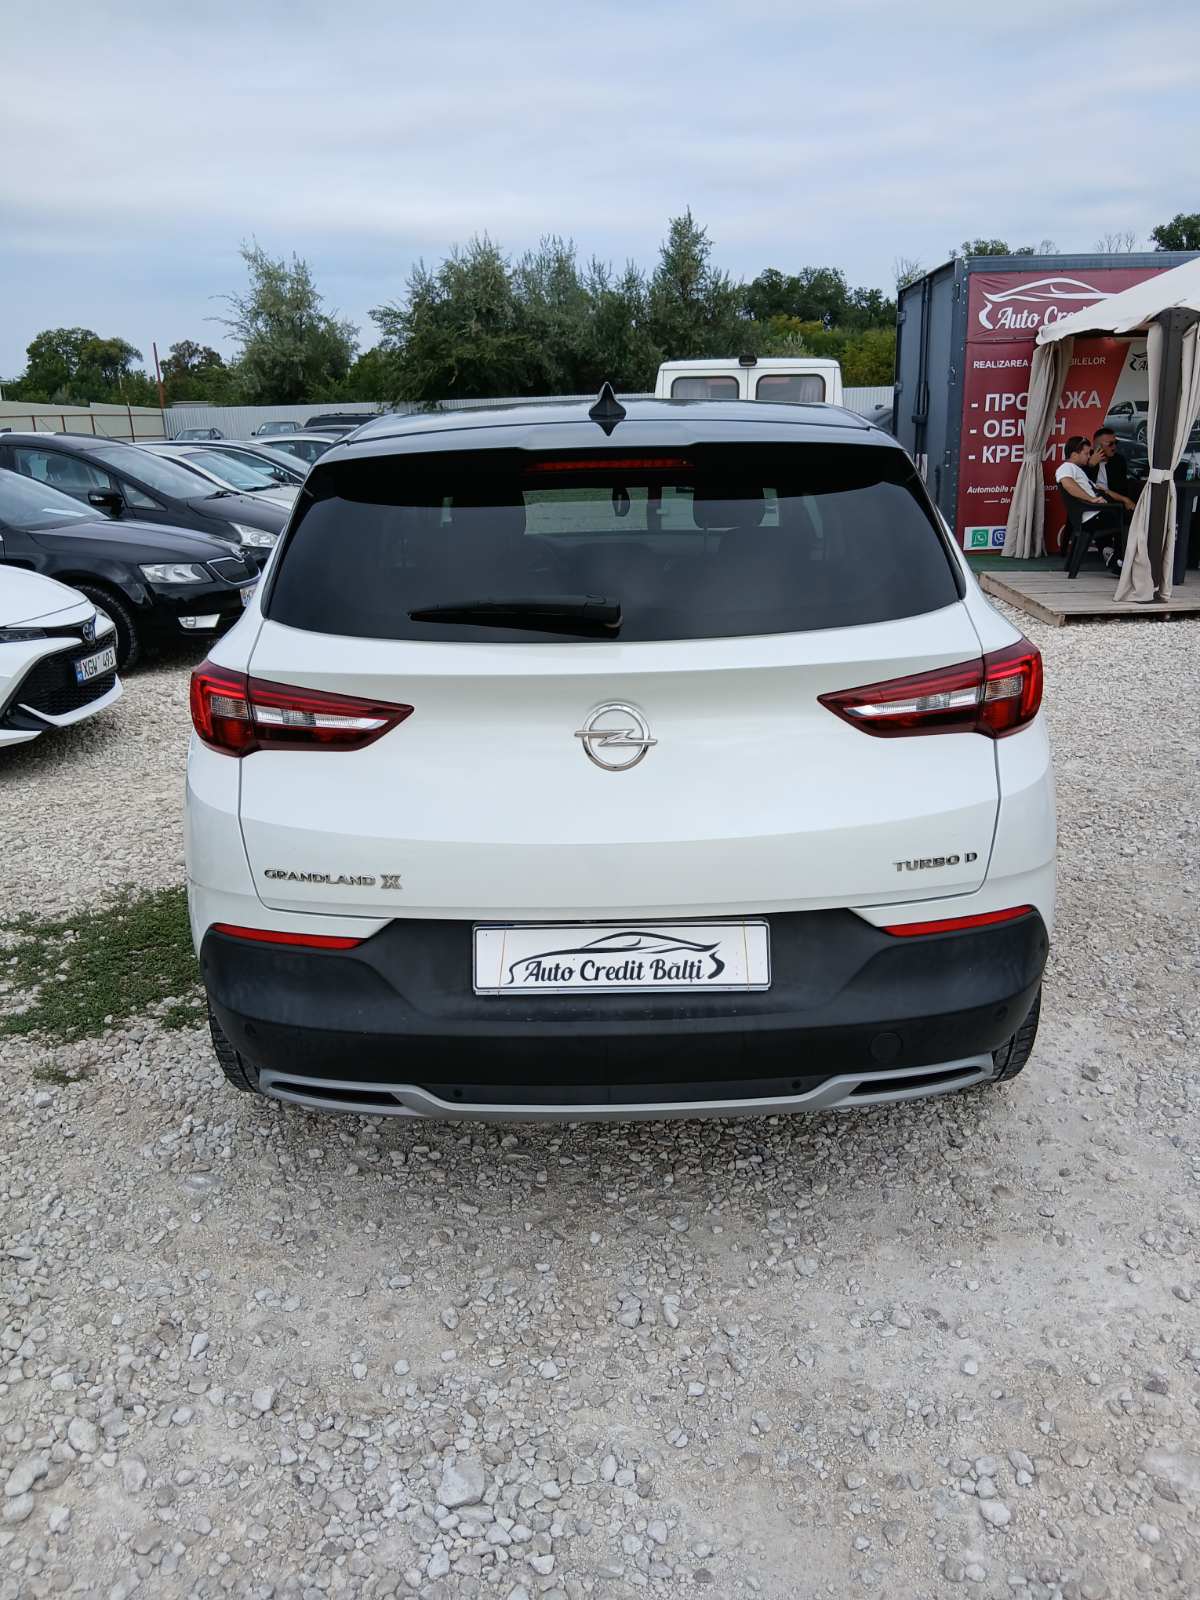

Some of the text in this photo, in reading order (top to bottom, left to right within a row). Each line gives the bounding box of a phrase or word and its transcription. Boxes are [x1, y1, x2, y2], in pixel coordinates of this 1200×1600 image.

[995, 306, 1041, 330] Auto
[973, 359, 1028, 369] REALIZAREA
[982, 443, 1067, 463] КРЕИТ
[966, 484, 1009, 494] Automobile
[103, 650, 114, 668] 493
[893, 852, 978, 872] TURBO D
[264, 868, 403, 890] GRANDLAND X
[523, 960, 576, 982] Auto
[579, 959, 645, 982] Credit
